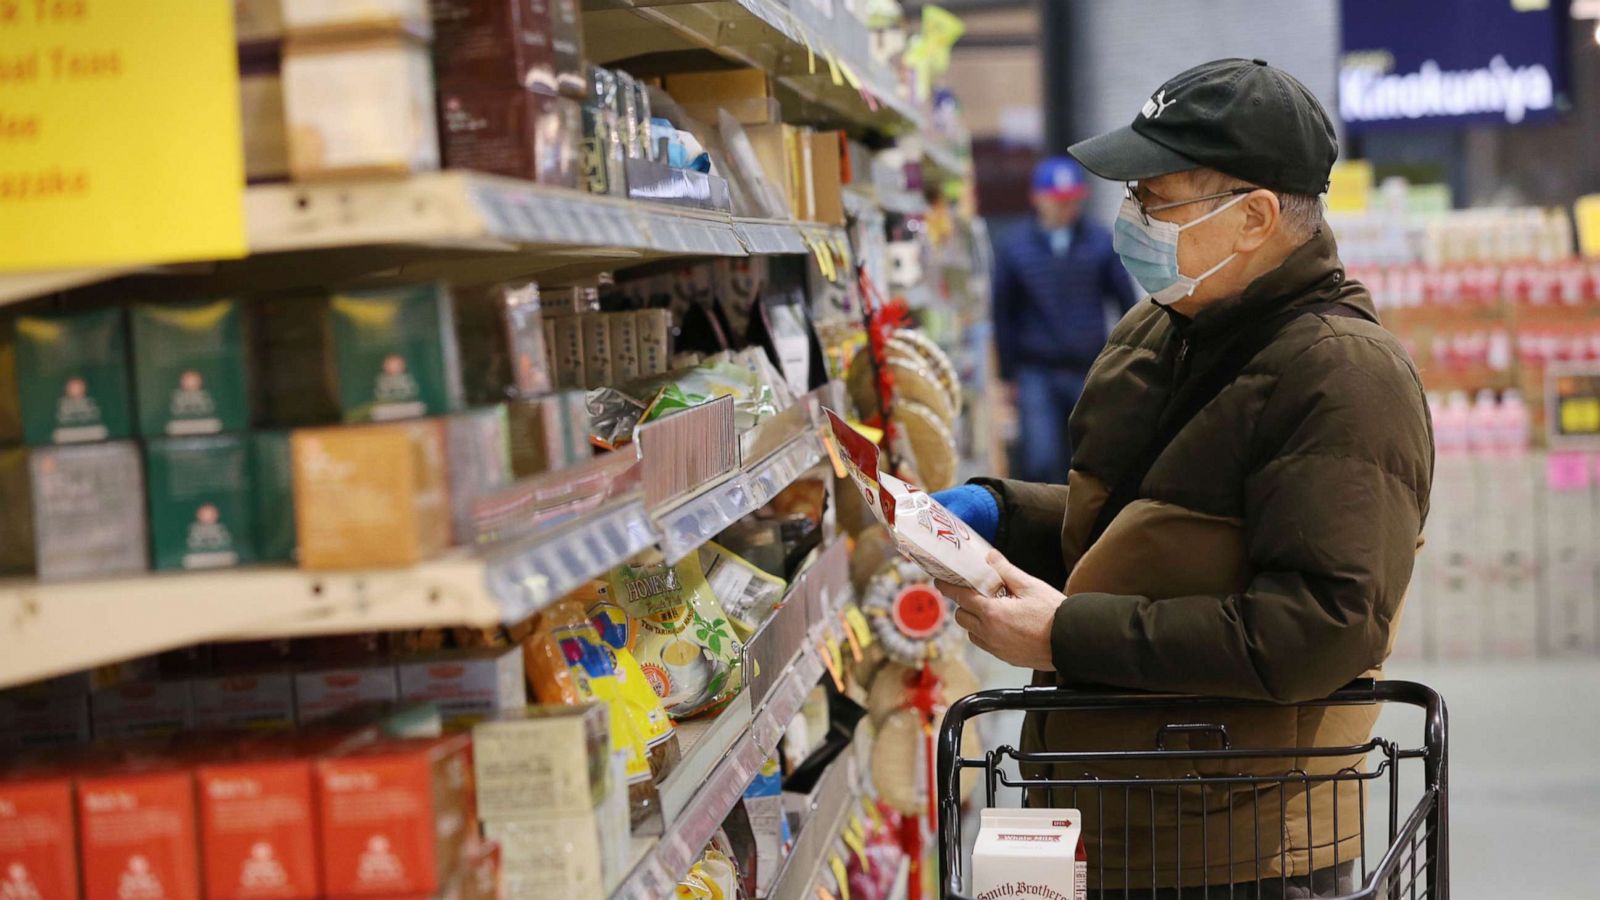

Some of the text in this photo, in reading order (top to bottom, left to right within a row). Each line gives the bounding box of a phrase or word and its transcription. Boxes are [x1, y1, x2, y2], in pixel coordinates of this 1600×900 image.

[52, 46, 122, 80] Teas
[1340, 54, 1553, 123] Kinokuniya
[977, 882, 1014, 900] Smith
